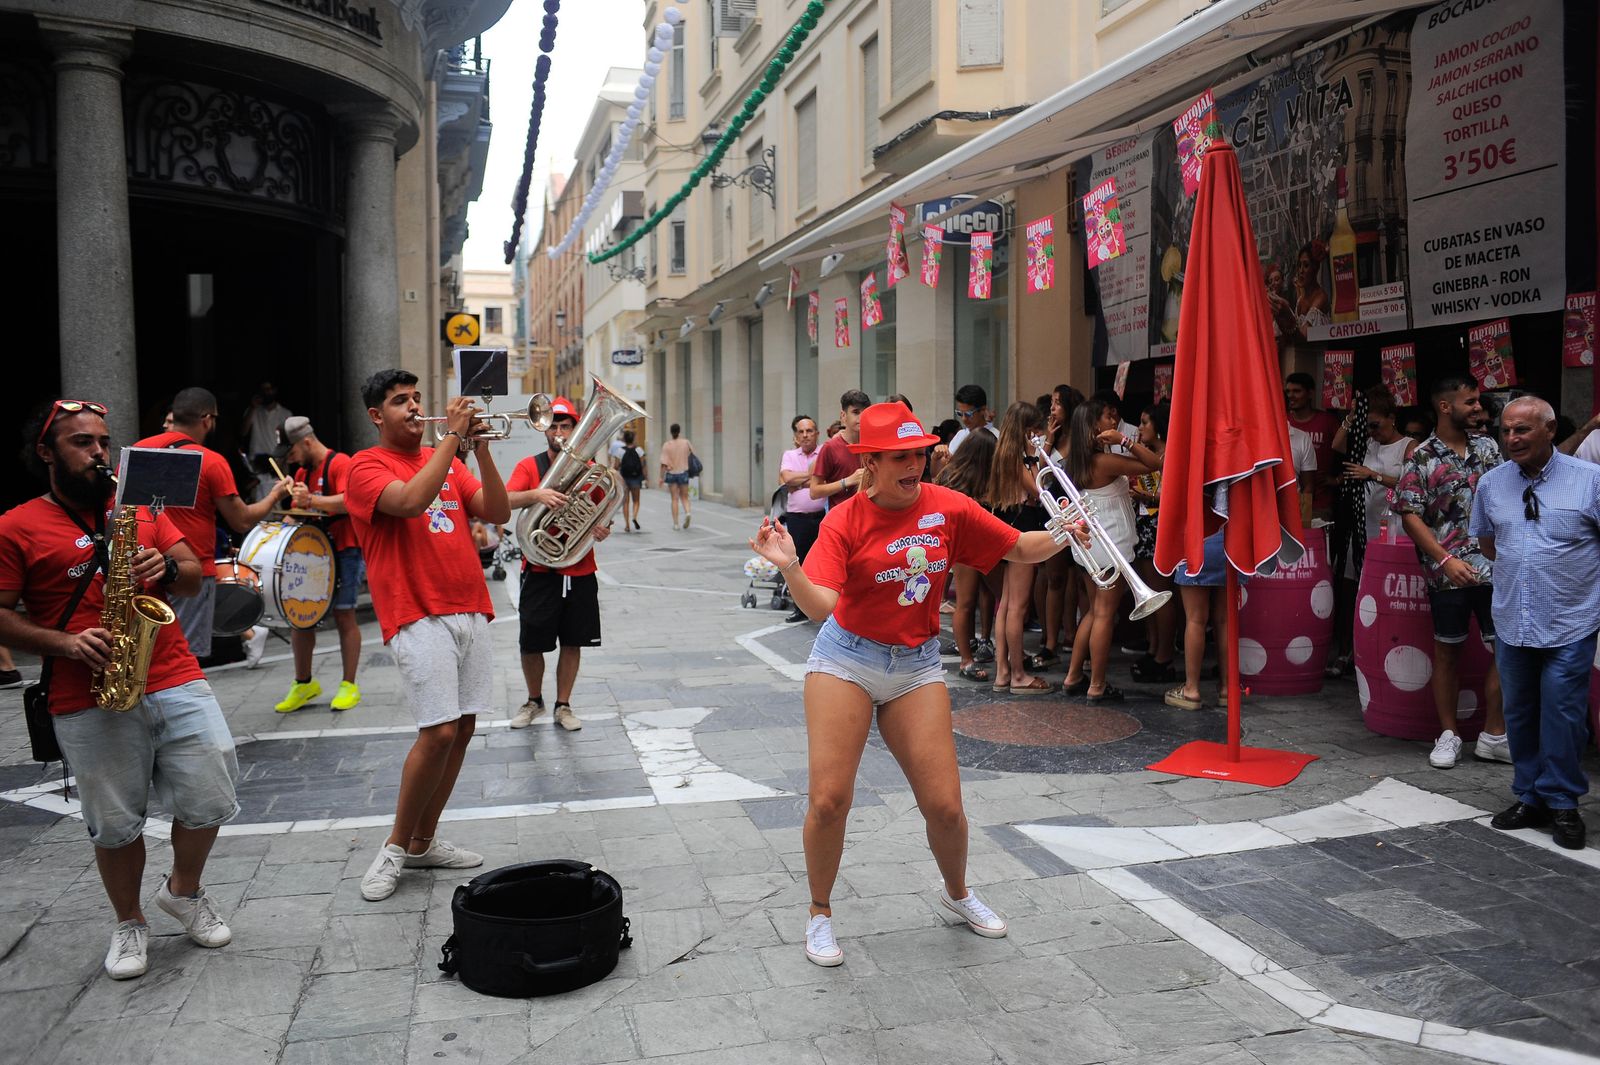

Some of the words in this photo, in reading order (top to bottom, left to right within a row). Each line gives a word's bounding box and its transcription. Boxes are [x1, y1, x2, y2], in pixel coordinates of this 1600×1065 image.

[1428, 0, 1495, 29] BOCAD
[1434, 40, 1479, 69] JAMON
[1482, 15, 1531, 48] COCIDO
[1427, 63, 1471, 91] JAMON
[1473, 36, 1540, 72] SERRANO
[1436, 64, 1524, 106] SALCHICHON
[1174, 94, 1213, 136] CARTOJAL
[1285, 76, 1354, 131] VITA
[1452, 94, 1502, 120] QUESO
[1443, 114, 1510, 144] TORTILLA
[1444, 138, 1517, 181] 3'50€
[1083, 181, 1115, 211] CARTOJAL
[1424, 230, 1481, 253] CUBATAS
[1484, 226, 1502, 242] EN
[1505, 217, 1545, 237] VASO
[1444, 255, 1462, 270] DE
[1465, 244, 1521, 266] MACETA
[1432, 274, 1489, 295] GINEBRA
[1500, 267, 1530, 285] RON
[1432, 297, 1481, 316] WHISKY
[1490, 288, 1542, 307] VODKA
[1329, 321, 1381, 338] CARTOJAL
[1469, 321, 1510, 341] CARTOJAL
[1324, 353, 1353, 364] CARTOJAL
[1381, 346, 1415, 360] CARTOJAL
[887, 534, 940, 555] CHARANGA
[876, 568, 900, 583] CRAZY
[927, 559, 947, 573] BRASS
[1384, 572, 1429, 600] CAR
